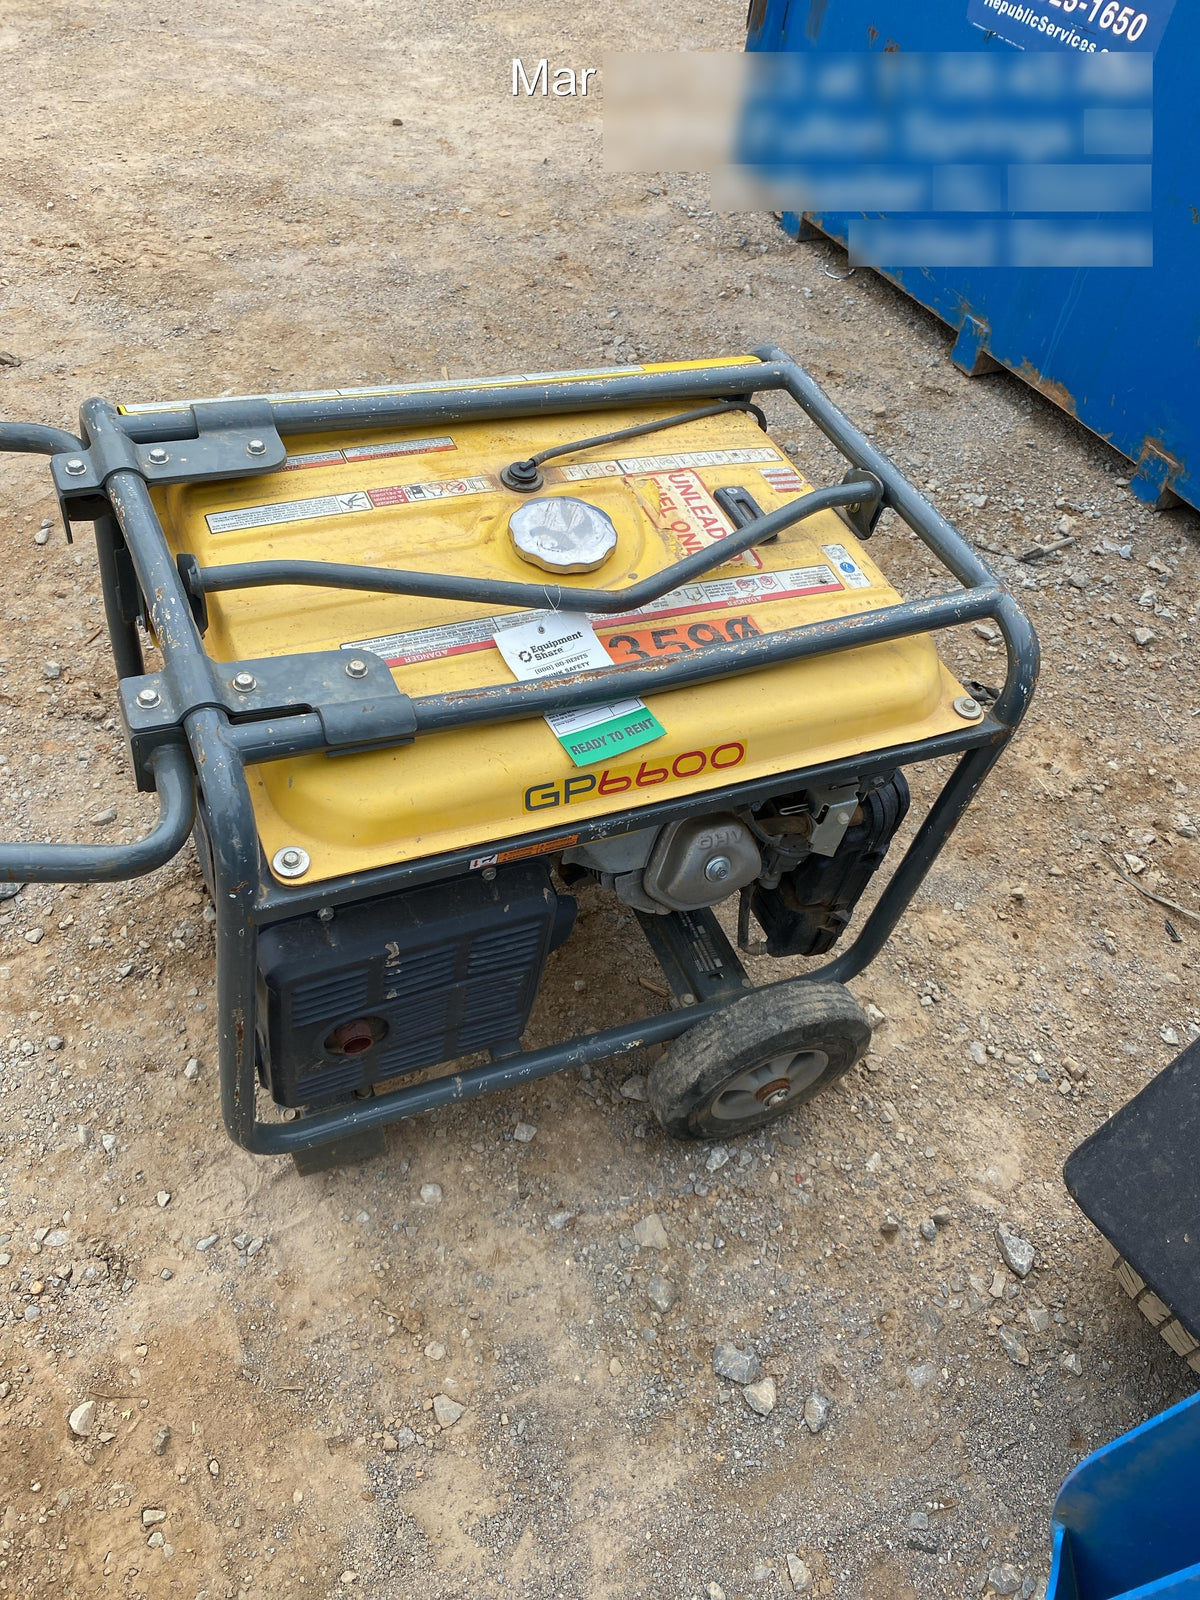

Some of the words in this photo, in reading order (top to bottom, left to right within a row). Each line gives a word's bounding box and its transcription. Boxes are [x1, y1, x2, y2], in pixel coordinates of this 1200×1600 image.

[1049, 0, 1147, 42] -1650
[649, 477, 678, 518] FEL
[668, 473, 743, 562] UNLEAD
[670, 520, 705, 555] ONL
[403, 650, 442, 663] DANGER
[529, 630, 583, 654] Equipment
[535, 647, 564, 661] Share
[564, 661, 590, 672] SAFETY
[569, 735, 607, 756] READY
[607, 730, 624, 743] TO
[624, 718, 655, 737] RENT
[524, 742, 745, 812] GP6600
